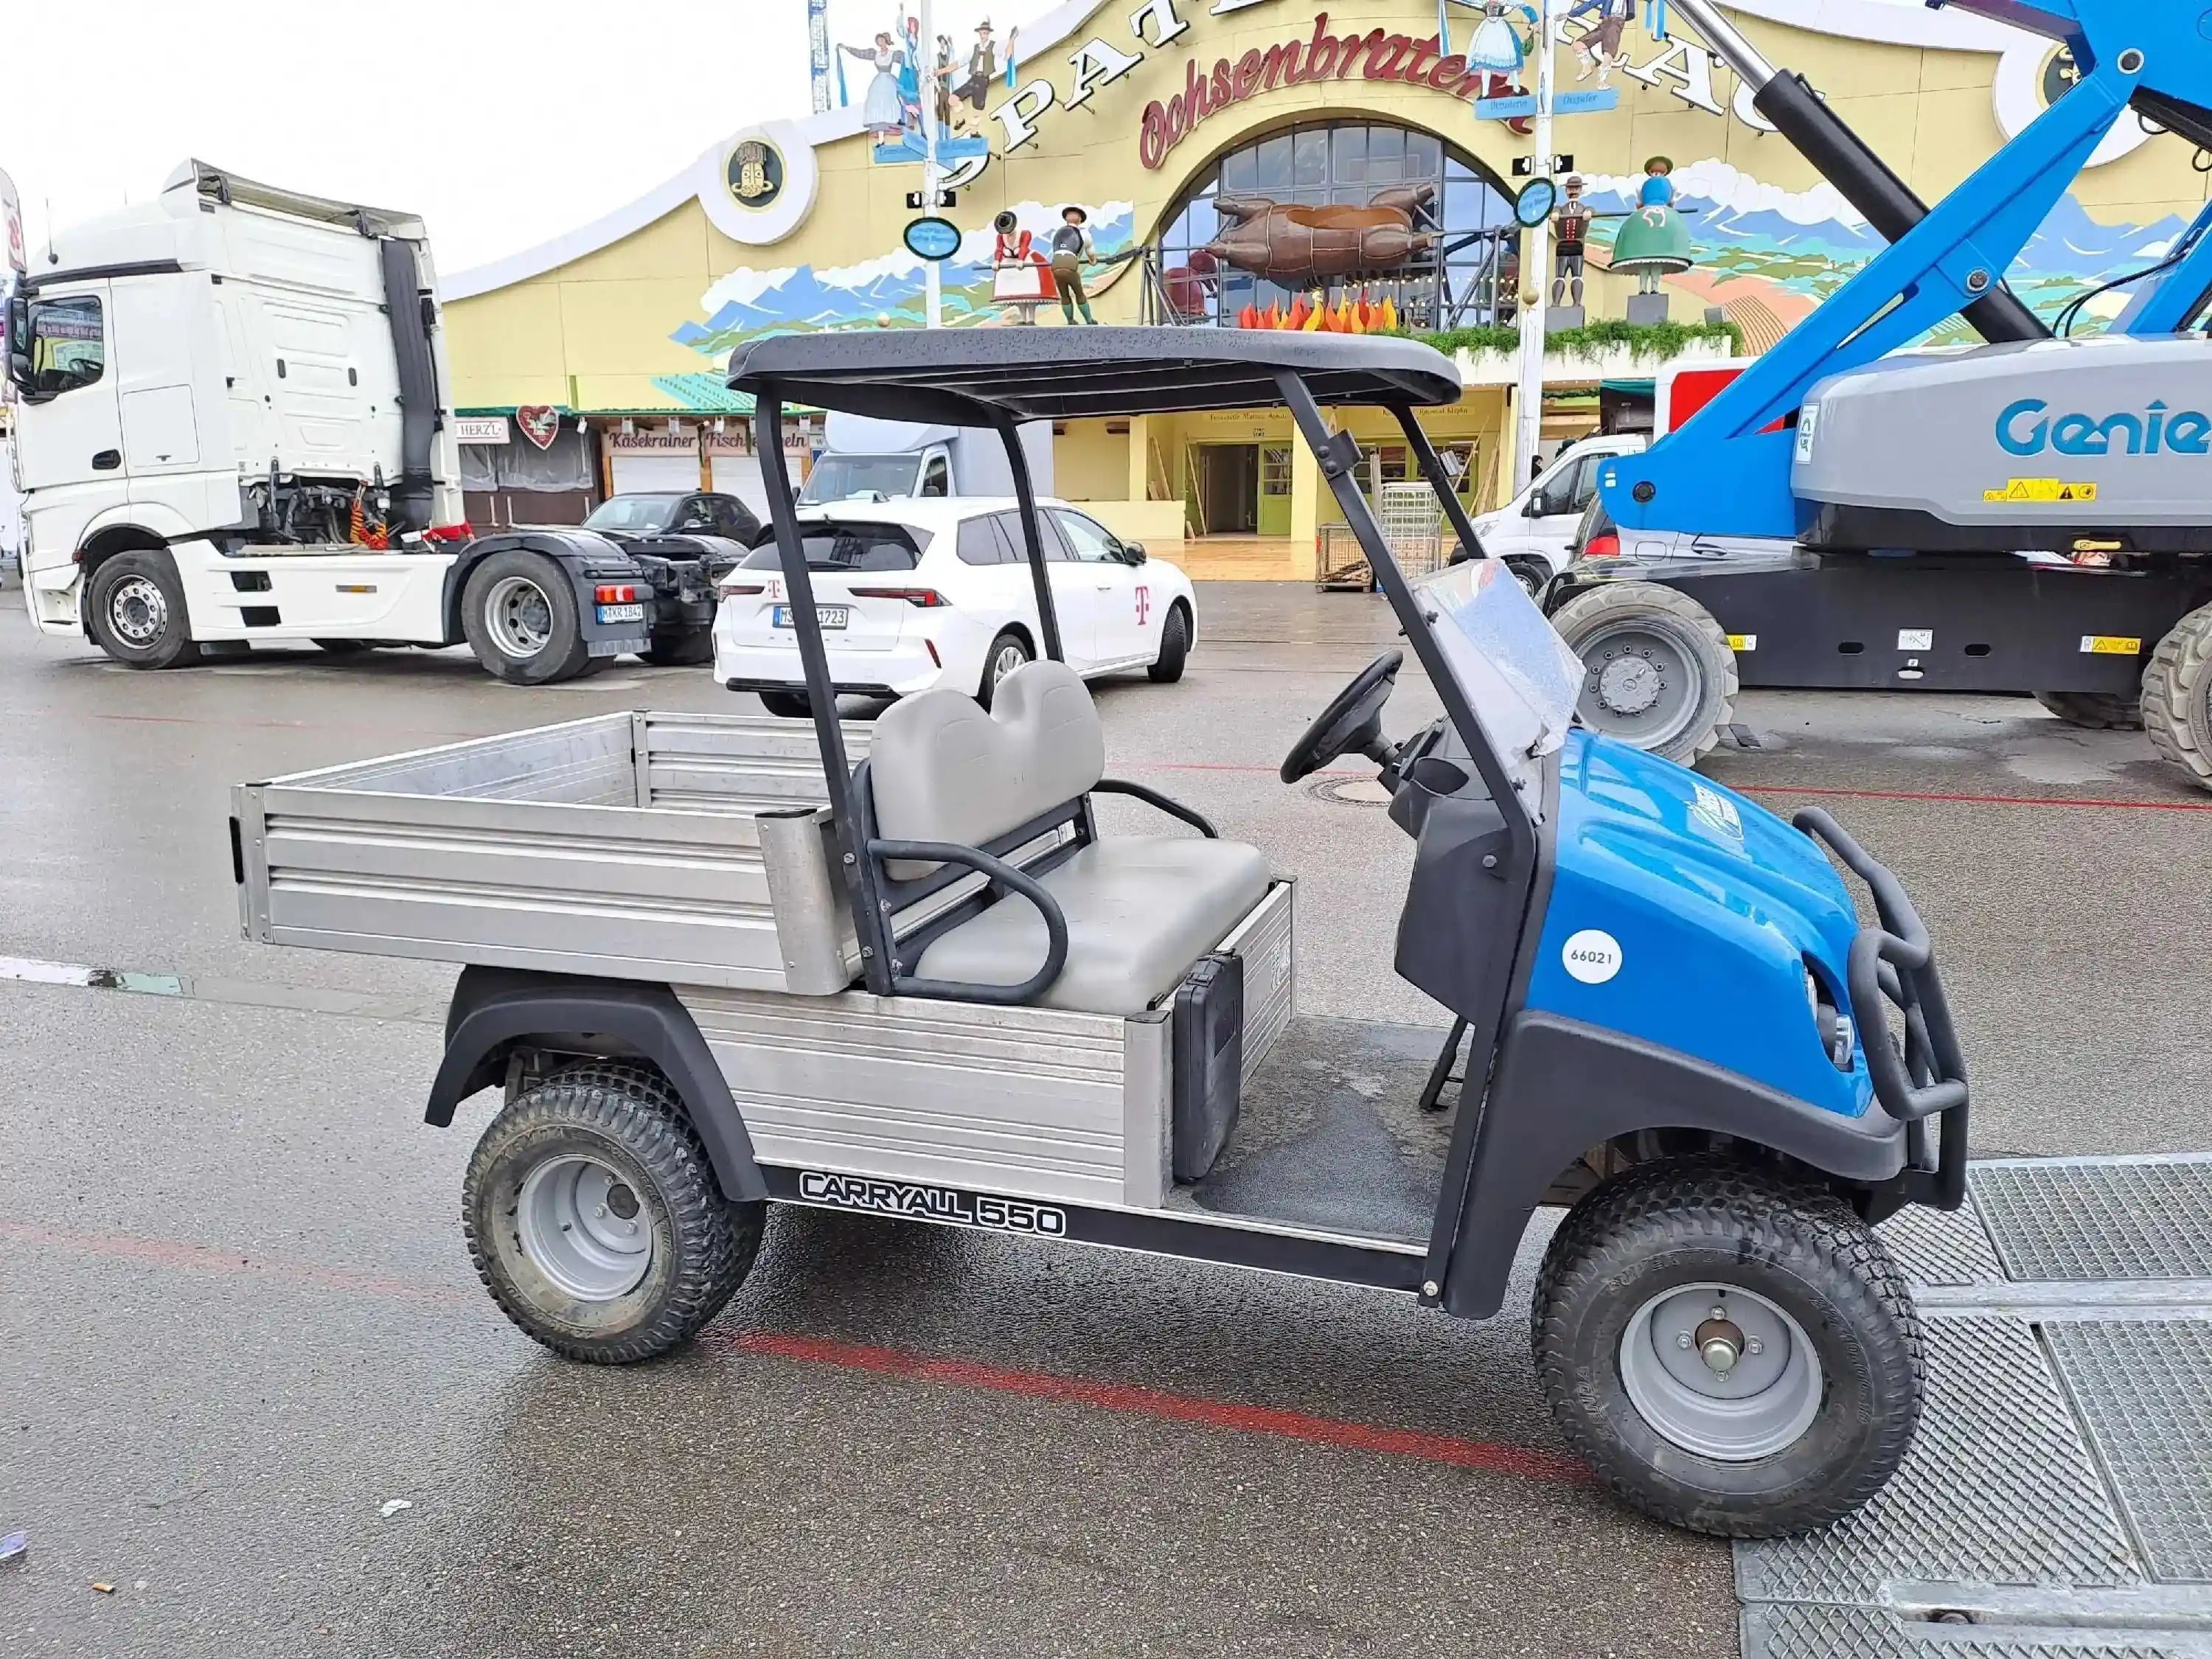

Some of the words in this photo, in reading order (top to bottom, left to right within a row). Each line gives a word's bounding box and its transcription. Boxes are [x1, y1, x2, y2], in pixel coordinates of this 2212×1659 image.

[1995, 398, 2212, 457] Genie
[609, 431, 696, 449] Käsekrainer
[818, 610, 845, 625] 1723
[1571, 949, 1613, 964] 66021
[799, 1171, 972, 1224] CARRYALL
[975, 1196, 1066, 1237] 550
